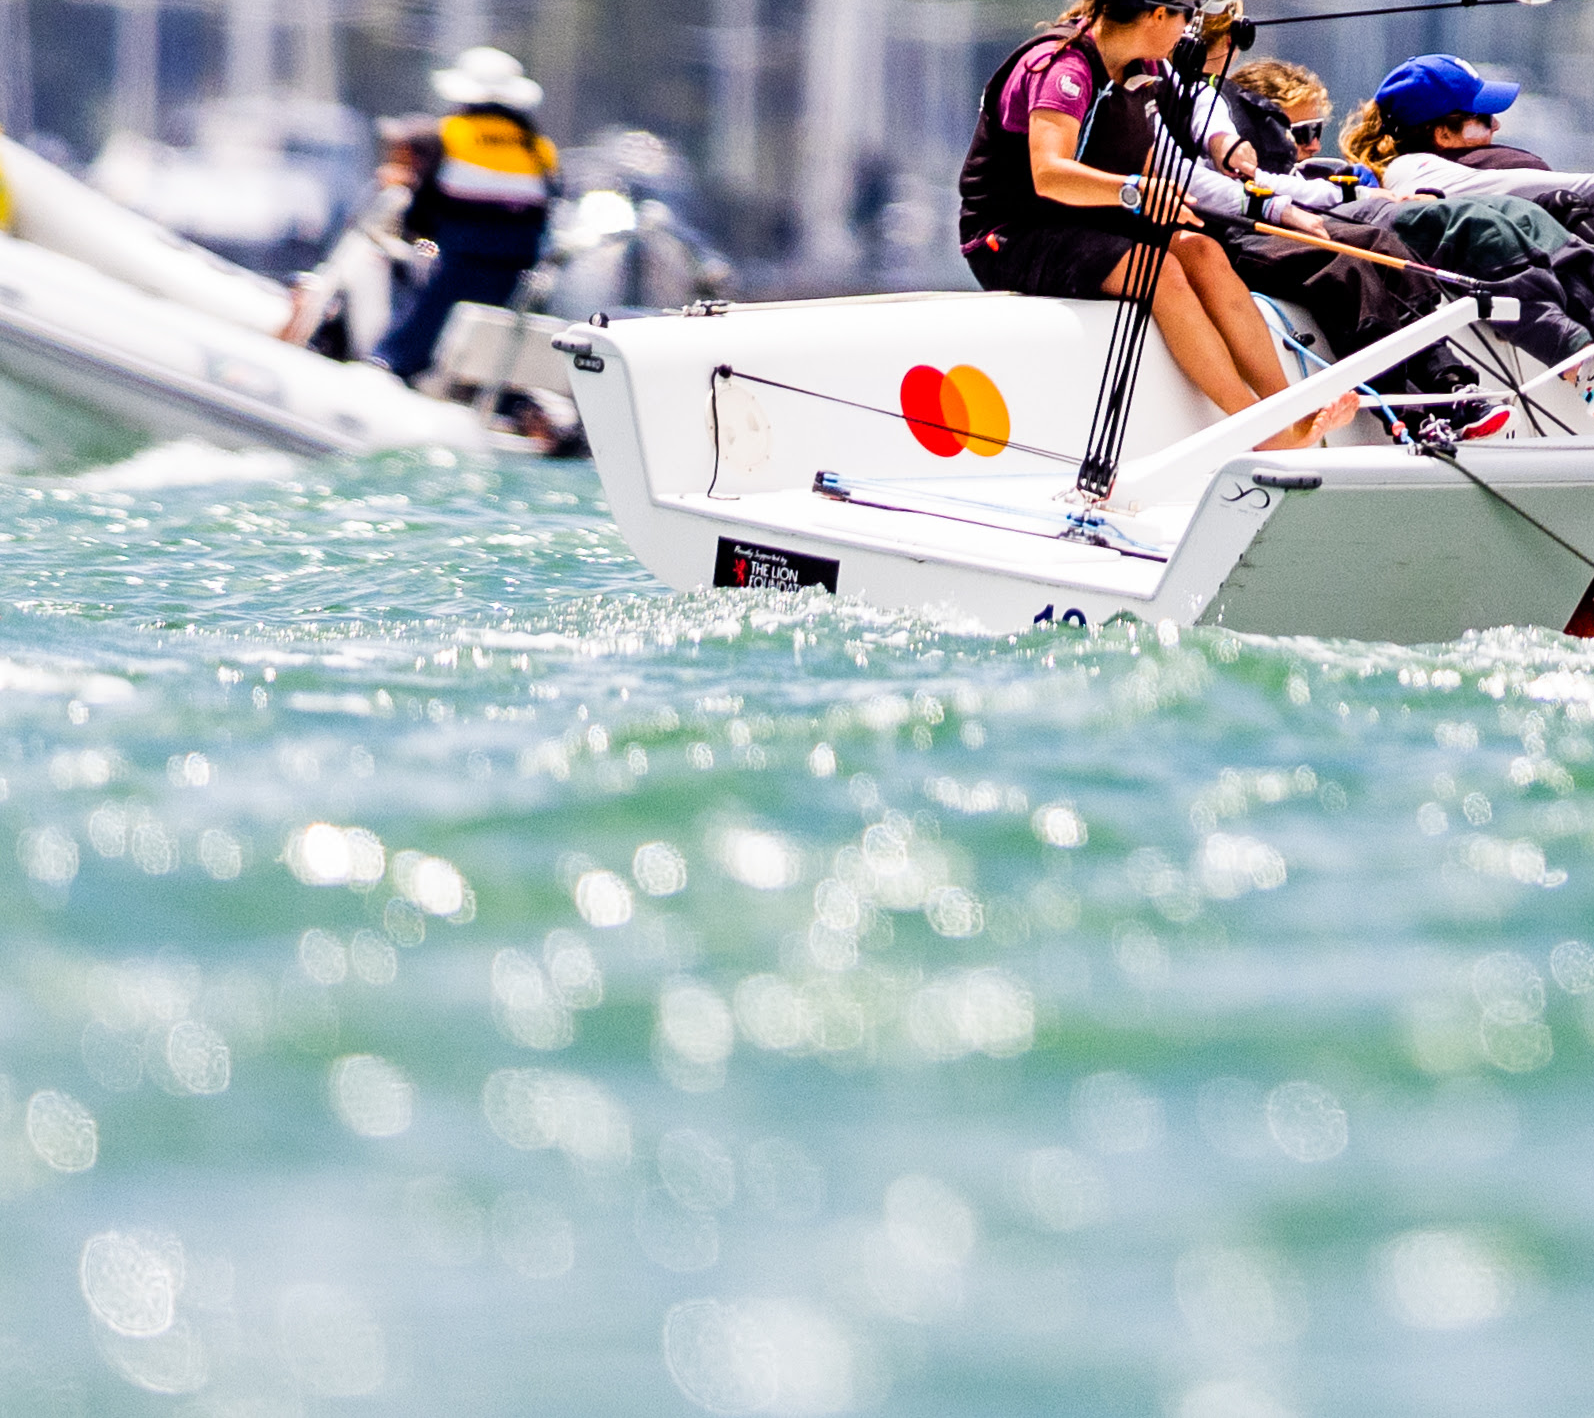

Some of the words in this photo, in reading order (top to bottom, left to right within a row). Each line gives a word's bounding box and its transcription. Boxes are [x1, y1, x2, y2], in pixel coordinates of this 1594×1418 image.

[751, 560, 771, 577] THE
[771, 565, 799, 583] LION
[748, 574, 802, 593] FOUNDAT
